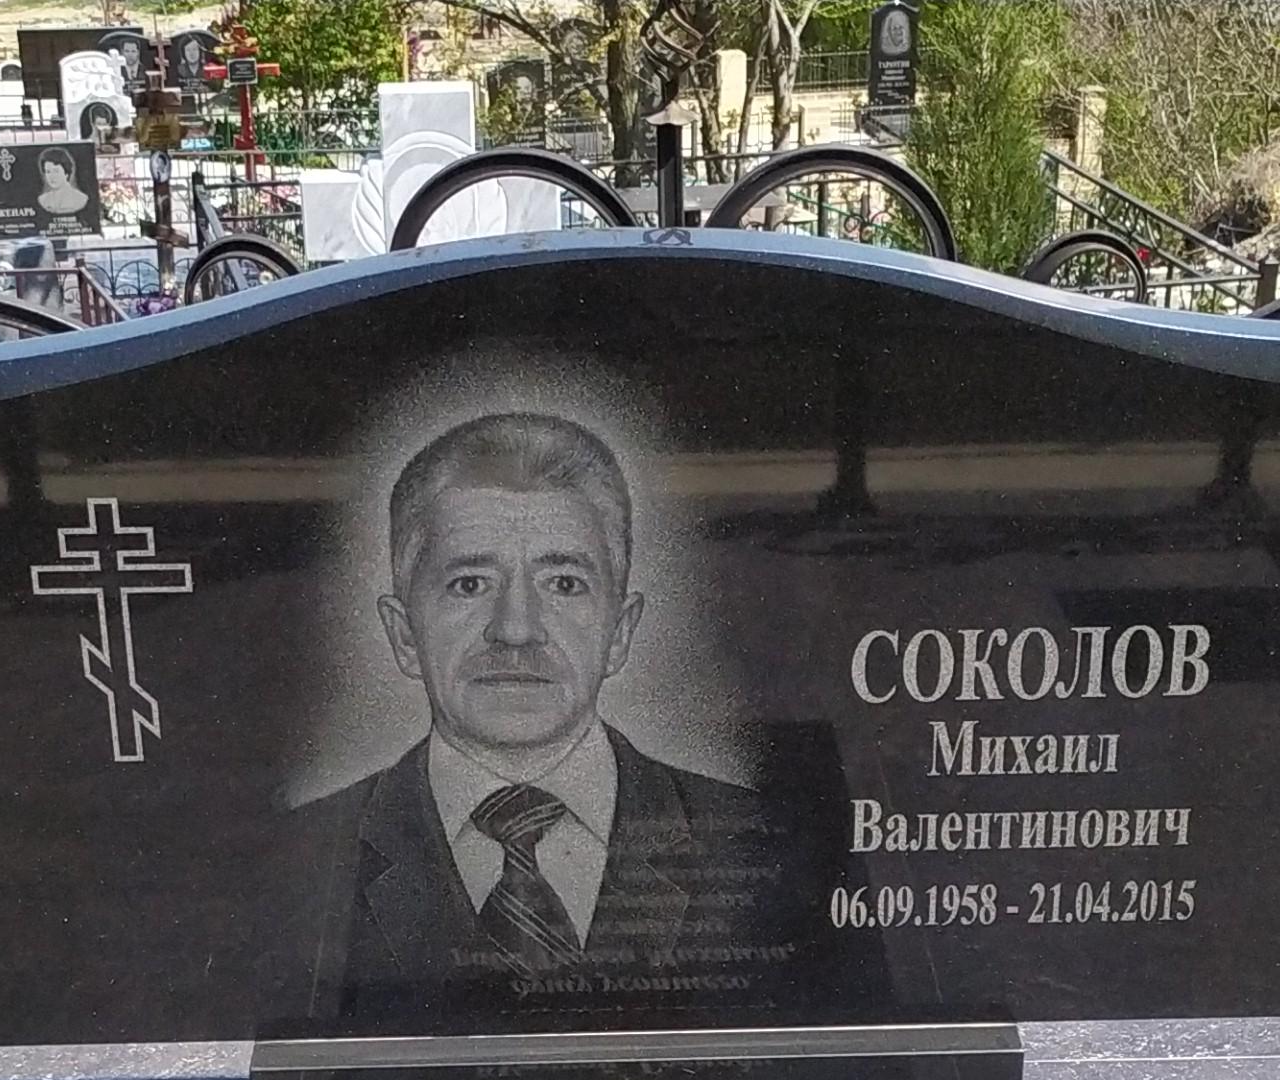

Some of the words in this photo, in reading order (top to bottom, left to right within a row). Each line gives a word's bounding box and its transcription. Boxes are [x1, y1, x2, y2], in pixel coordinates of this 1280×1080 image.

[851, 624, 1211, 704] СОКОЛОВ
[926, 720, 1121, 777] Михаил
[849, 799, 1192, 853] Валентинович
[830, 883, 997, 928] 06.09.1958
[1027, 880, 1197, 924] 21.04.2015
